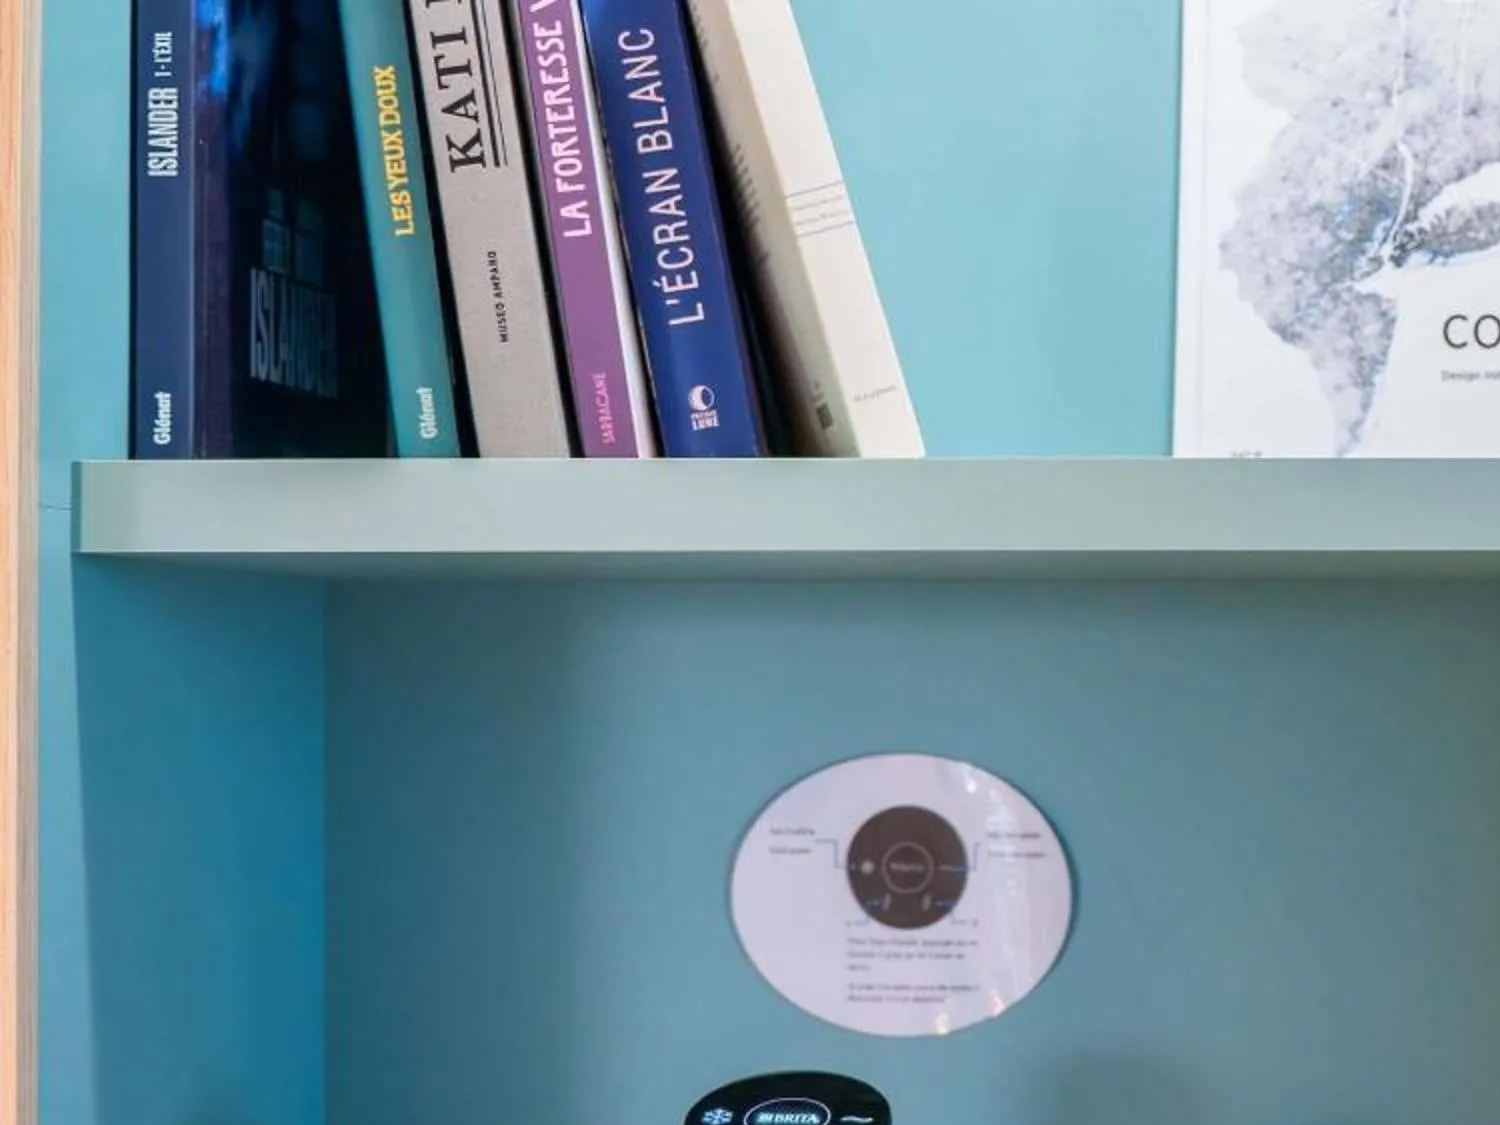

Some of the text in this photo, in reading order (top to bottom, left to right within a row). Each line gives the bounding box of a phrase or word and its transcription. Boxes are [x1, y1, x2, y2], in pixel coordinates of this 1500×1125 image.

[147, 87, 179, 177] ISLANDER
[430, 27, 488, 173] KATI
[533, 20, 591, 195] FORTERESSE
[373, 65, 415, 237] LES YEUX DOUX
[619, 28, 704, 327] L'ÉCRAN BLANC
[560, 200, 593, 238] LA
[249, 267, 338, 400] ISLAN
[1441, 369, 1481, 383] Design
[154, 392, 171, 445] Glénat
[421, 386, 437, 440] Glénat
[774, 1112, 821, 1124] BRITA
